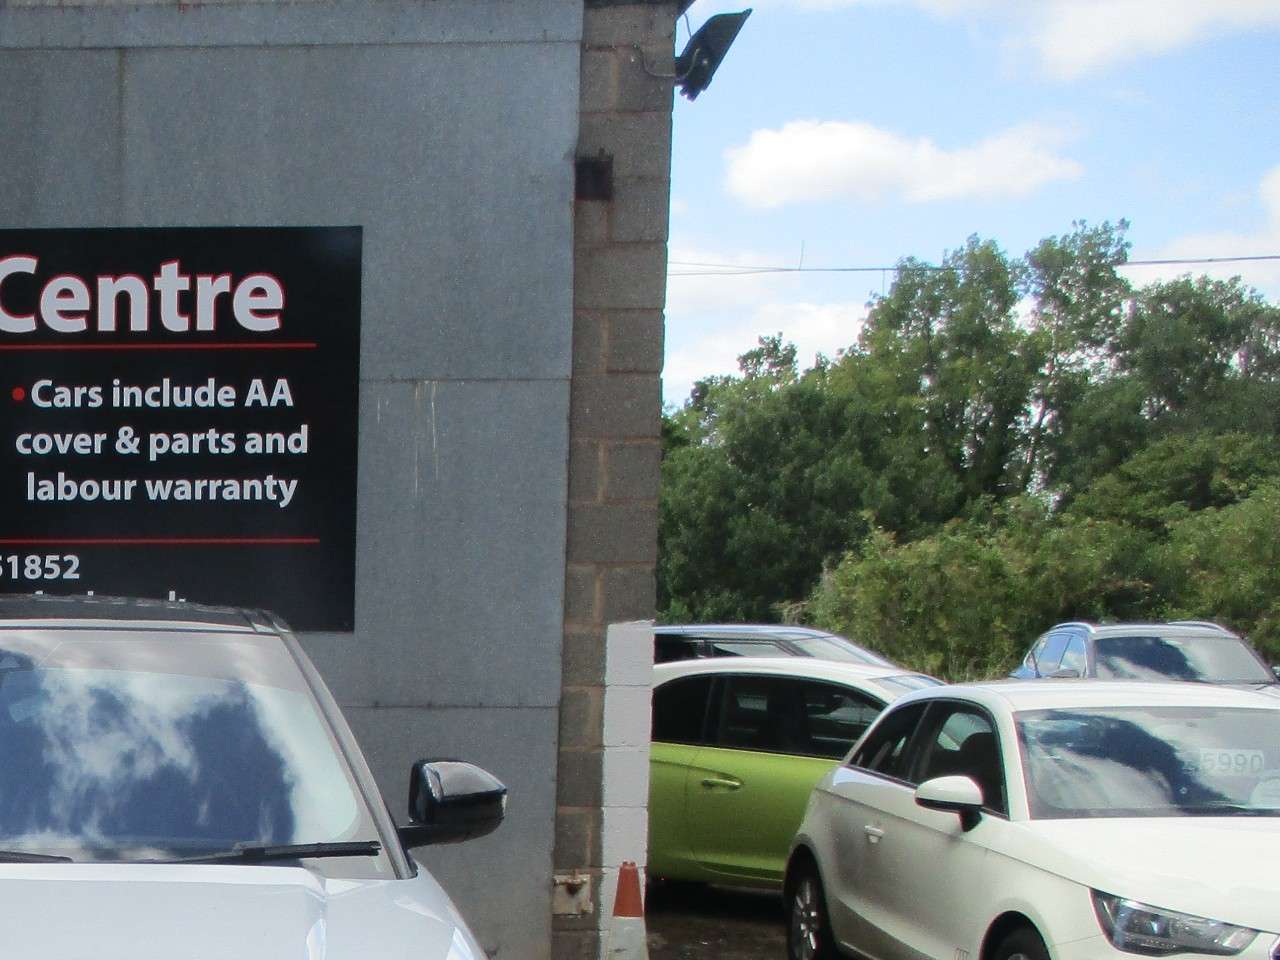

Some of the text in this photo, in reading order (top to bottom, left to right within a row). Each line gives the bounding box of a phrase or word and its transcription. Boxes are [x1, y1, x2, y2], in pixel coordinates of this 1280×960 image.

[30, 377, 294, 408] Cars include AA
[15, 423, 309, 462] cover & parts and
[27, 471, 298, 508] labour warranty
